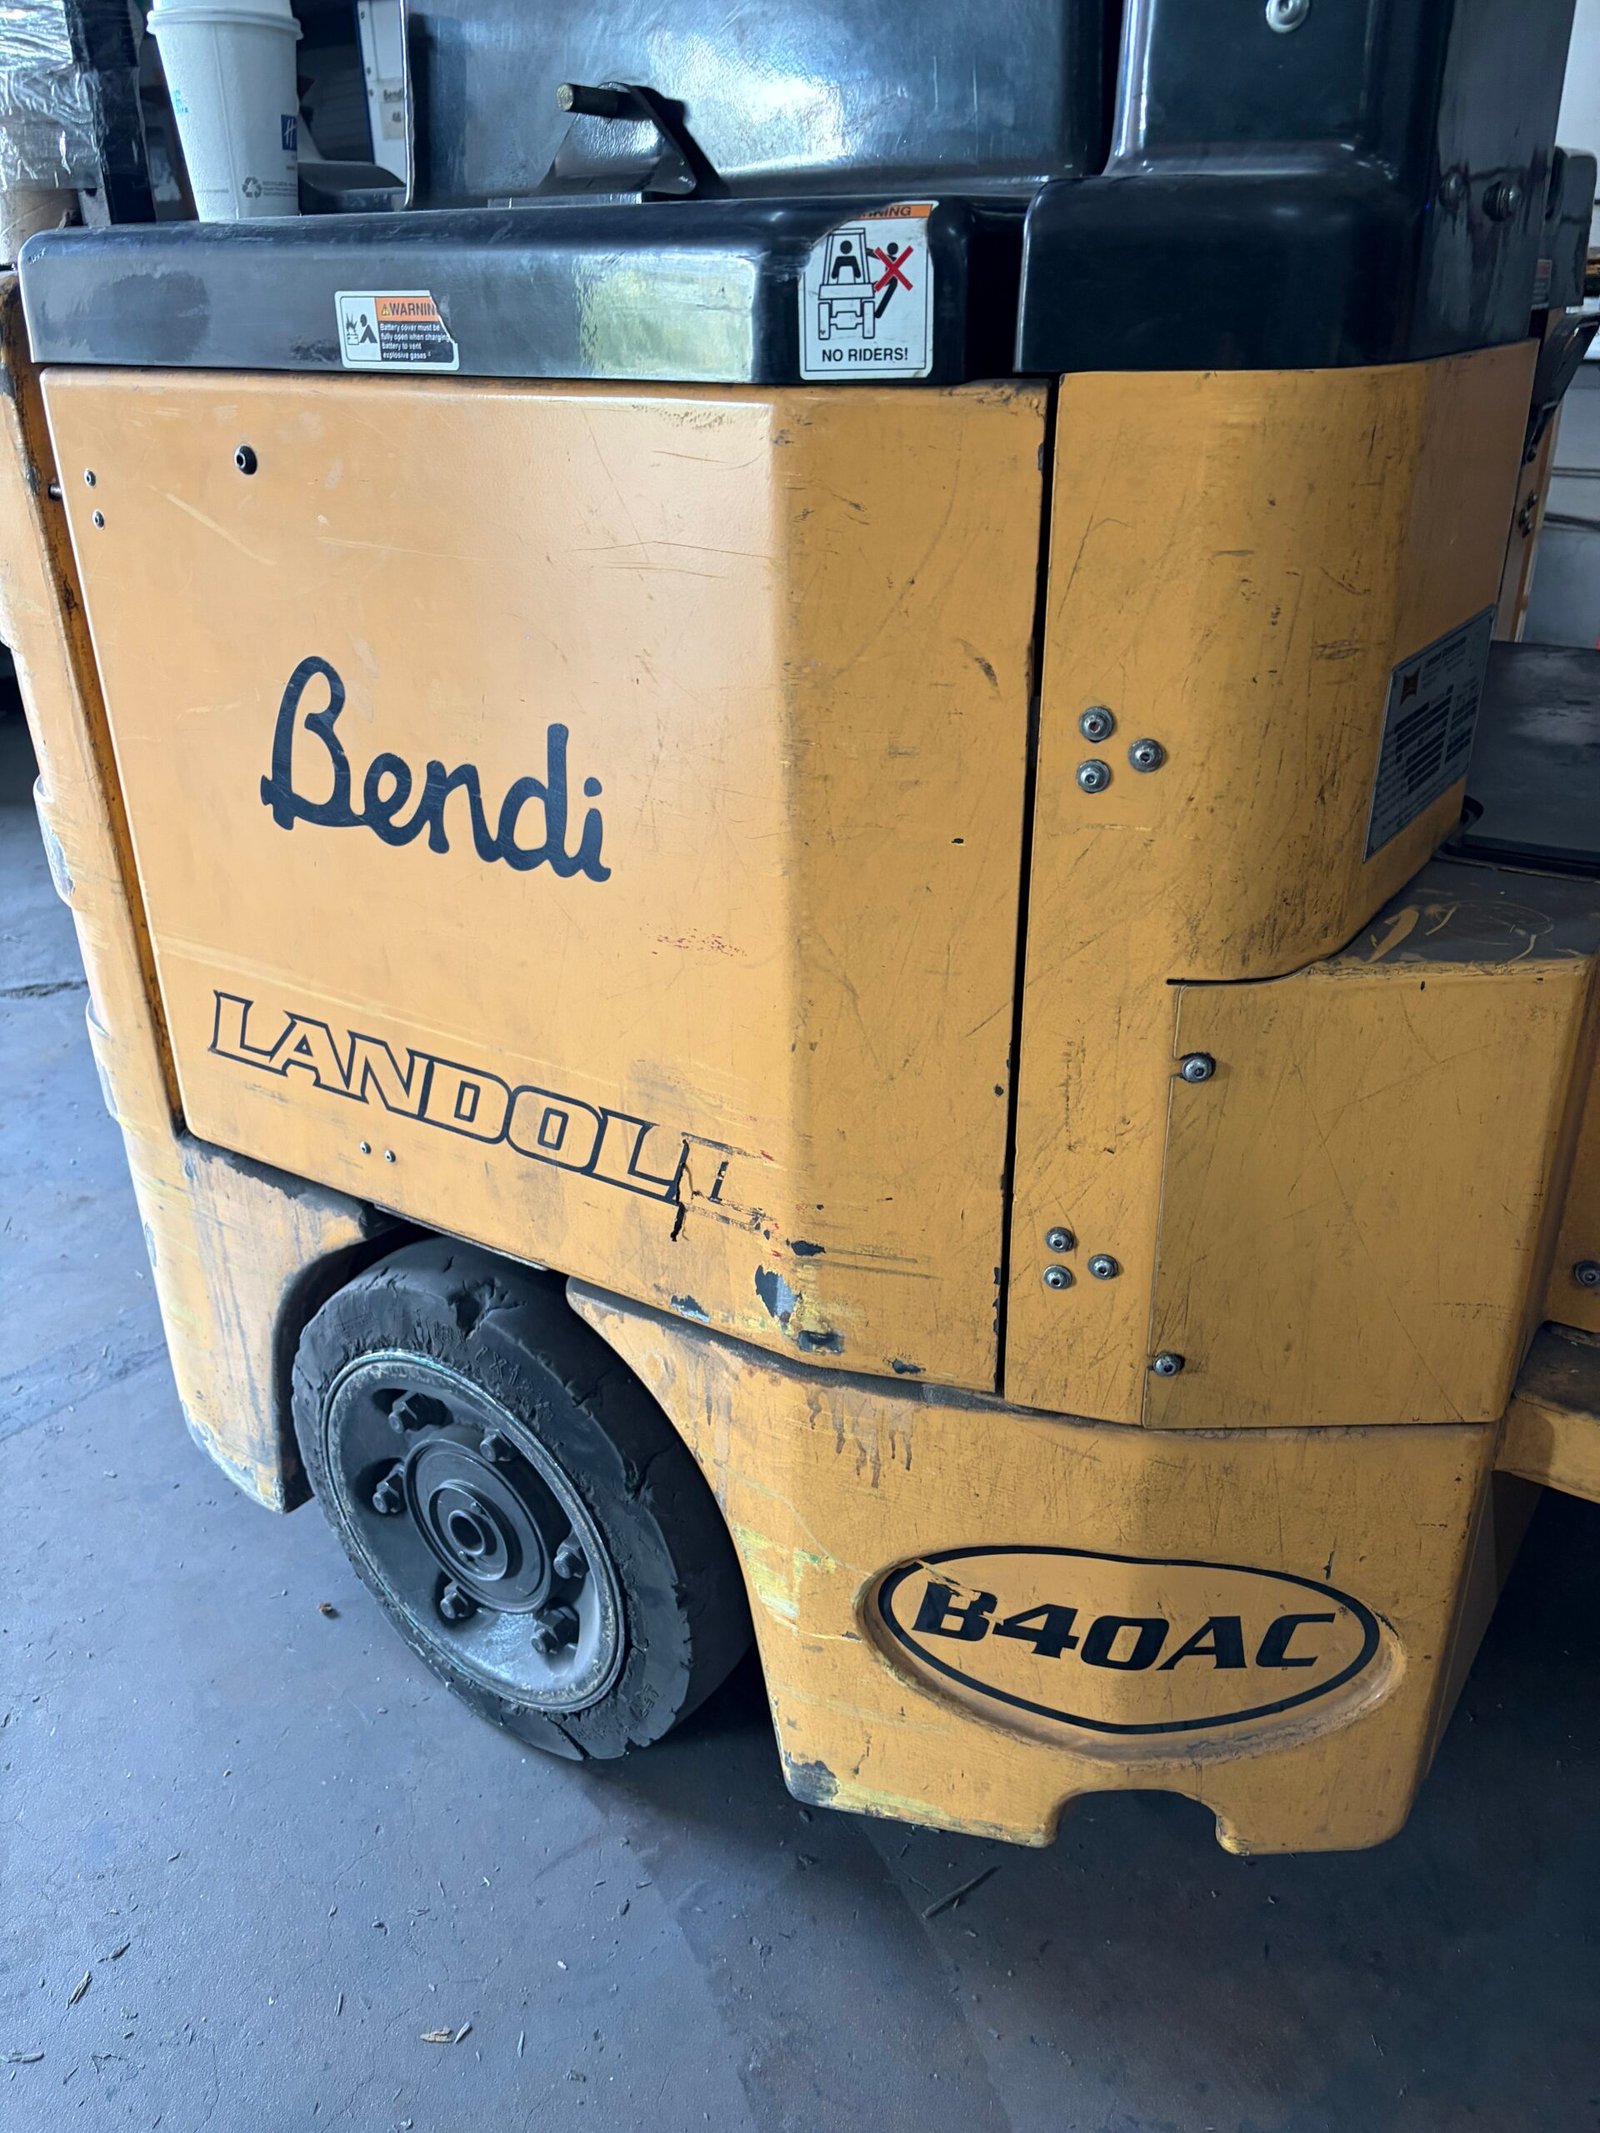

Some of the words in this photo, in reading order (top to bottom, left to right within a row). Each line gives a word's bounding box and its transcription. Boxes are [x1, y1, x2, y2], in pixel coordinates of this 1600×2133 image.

[380, 323, 400, 333] Battery
[400, 324, 417, 332] cover
[417, 324, 432, 332] must
[432, 324, 440, 332] be
[380, 332, 393, 341] fully
[394, 333, 408, 341] open
[409, 333, 424, 341] when
[382, 342, 401, 351] battery
[402, 342, 409, 350] to
[409, 342, 422, 350] vent
[383, 351, 409, 360] explosive
[410, 352, 427, 361] gases
[822, 349, 844, 362] NO
[848, 348, 908, 362] RIDERS!
[260, 655, 612, 883] Bendi
[912, 1580, 1337, 1671] B40AC
